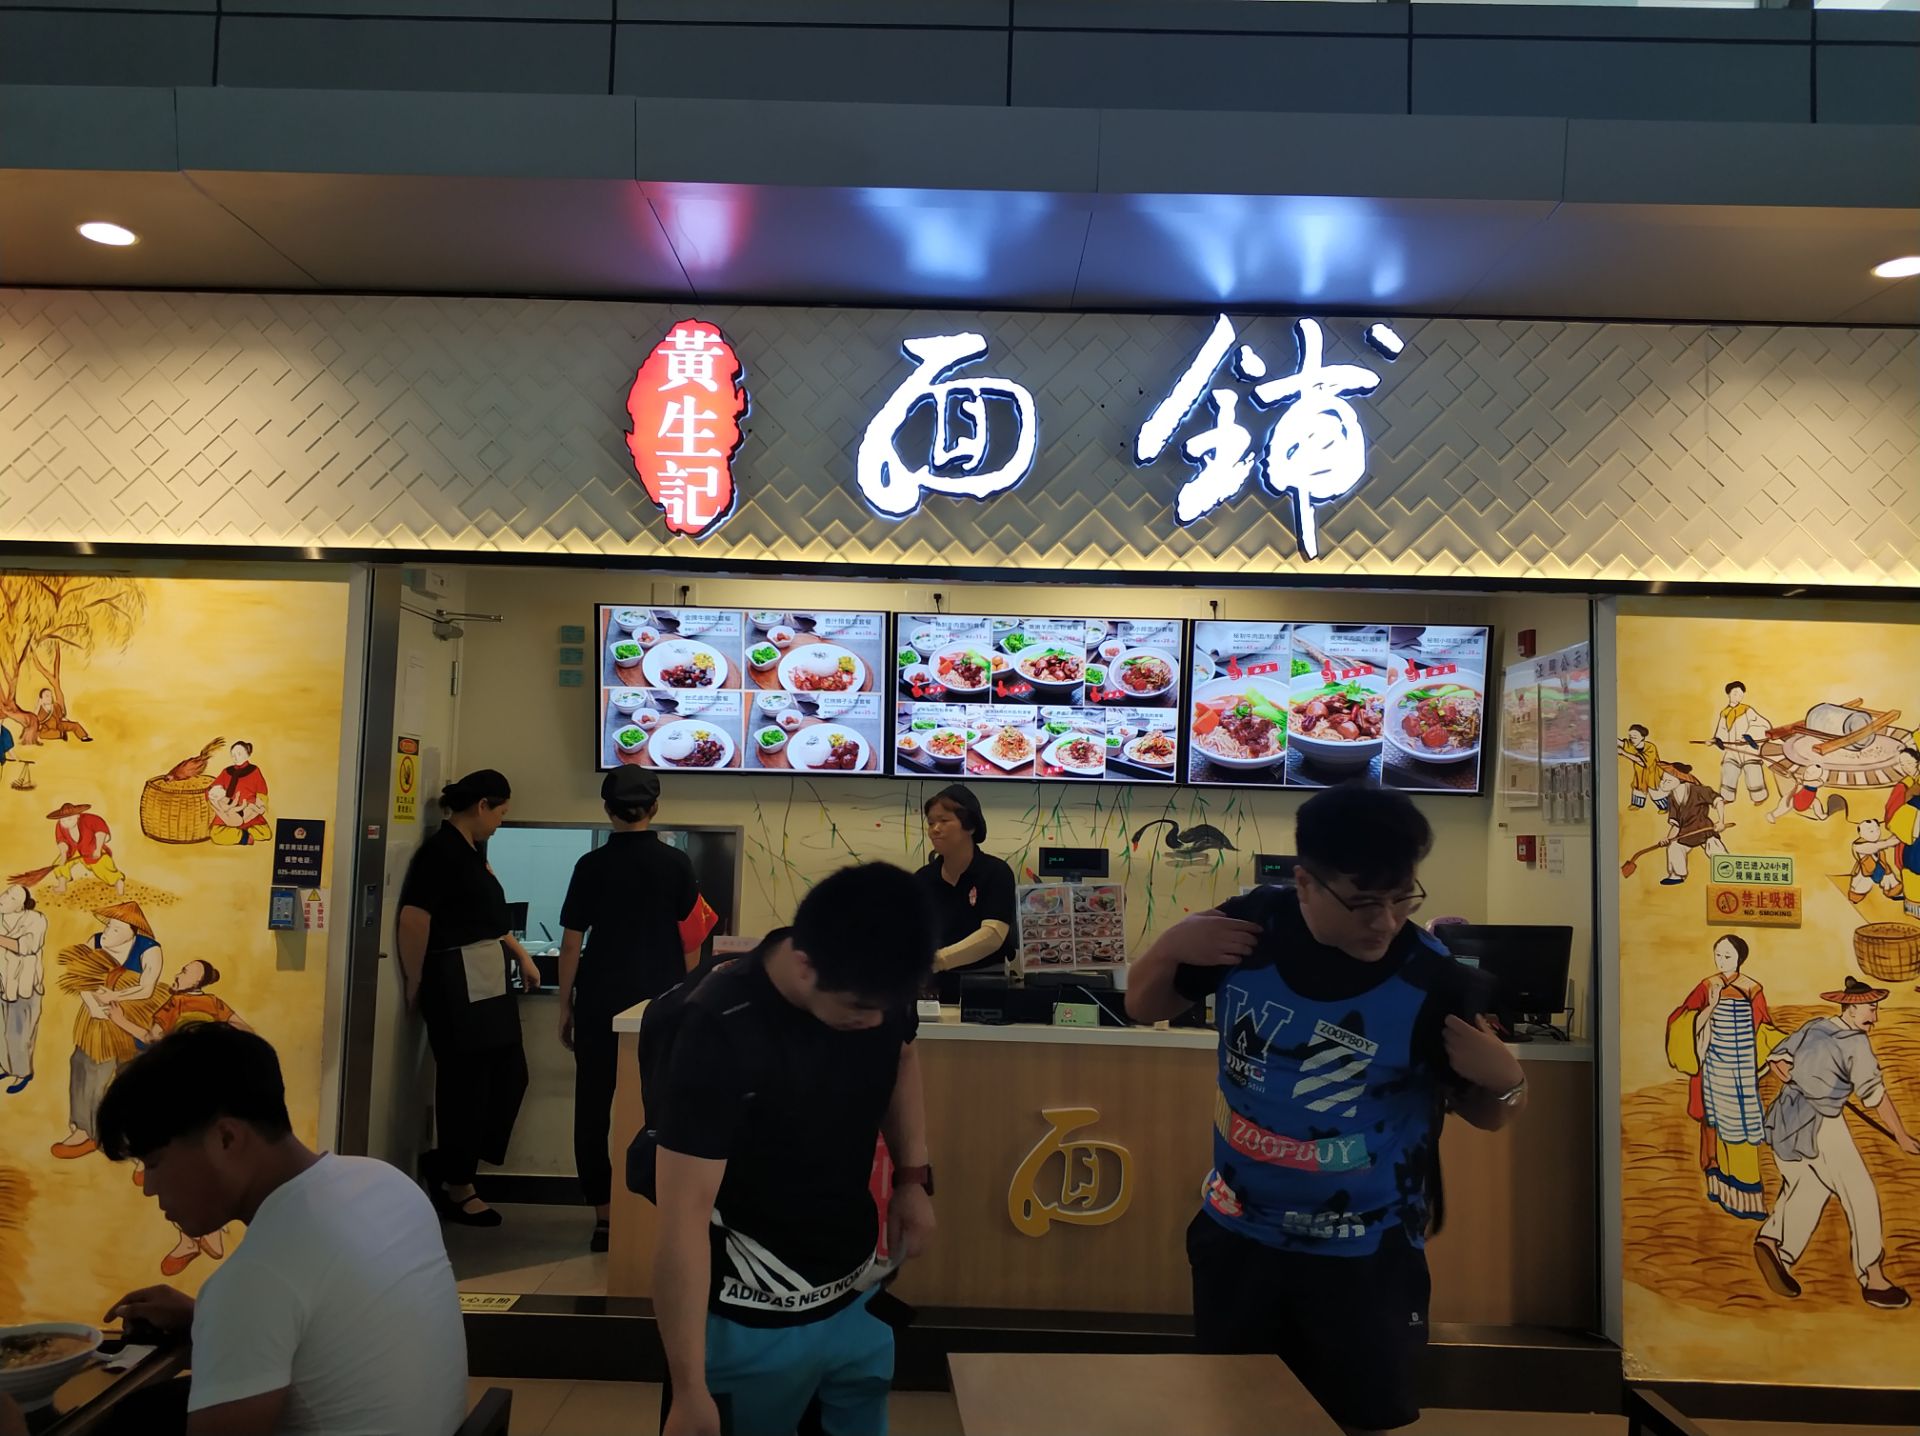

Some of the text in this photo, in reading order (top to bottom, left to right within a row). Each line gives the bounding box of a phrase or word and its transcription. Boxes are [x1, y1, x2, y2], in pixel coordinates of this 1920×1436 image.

[1535, 649, 1589, 679] 证照公示
[1742, 890, 1795, 909] 禁止吸烟
[1319, 1022, 1375, 1052] ZOOPBOY
[726, 1283, 796, 1308] ADIDAS
[798, 1287, 832, 1307] NEO
